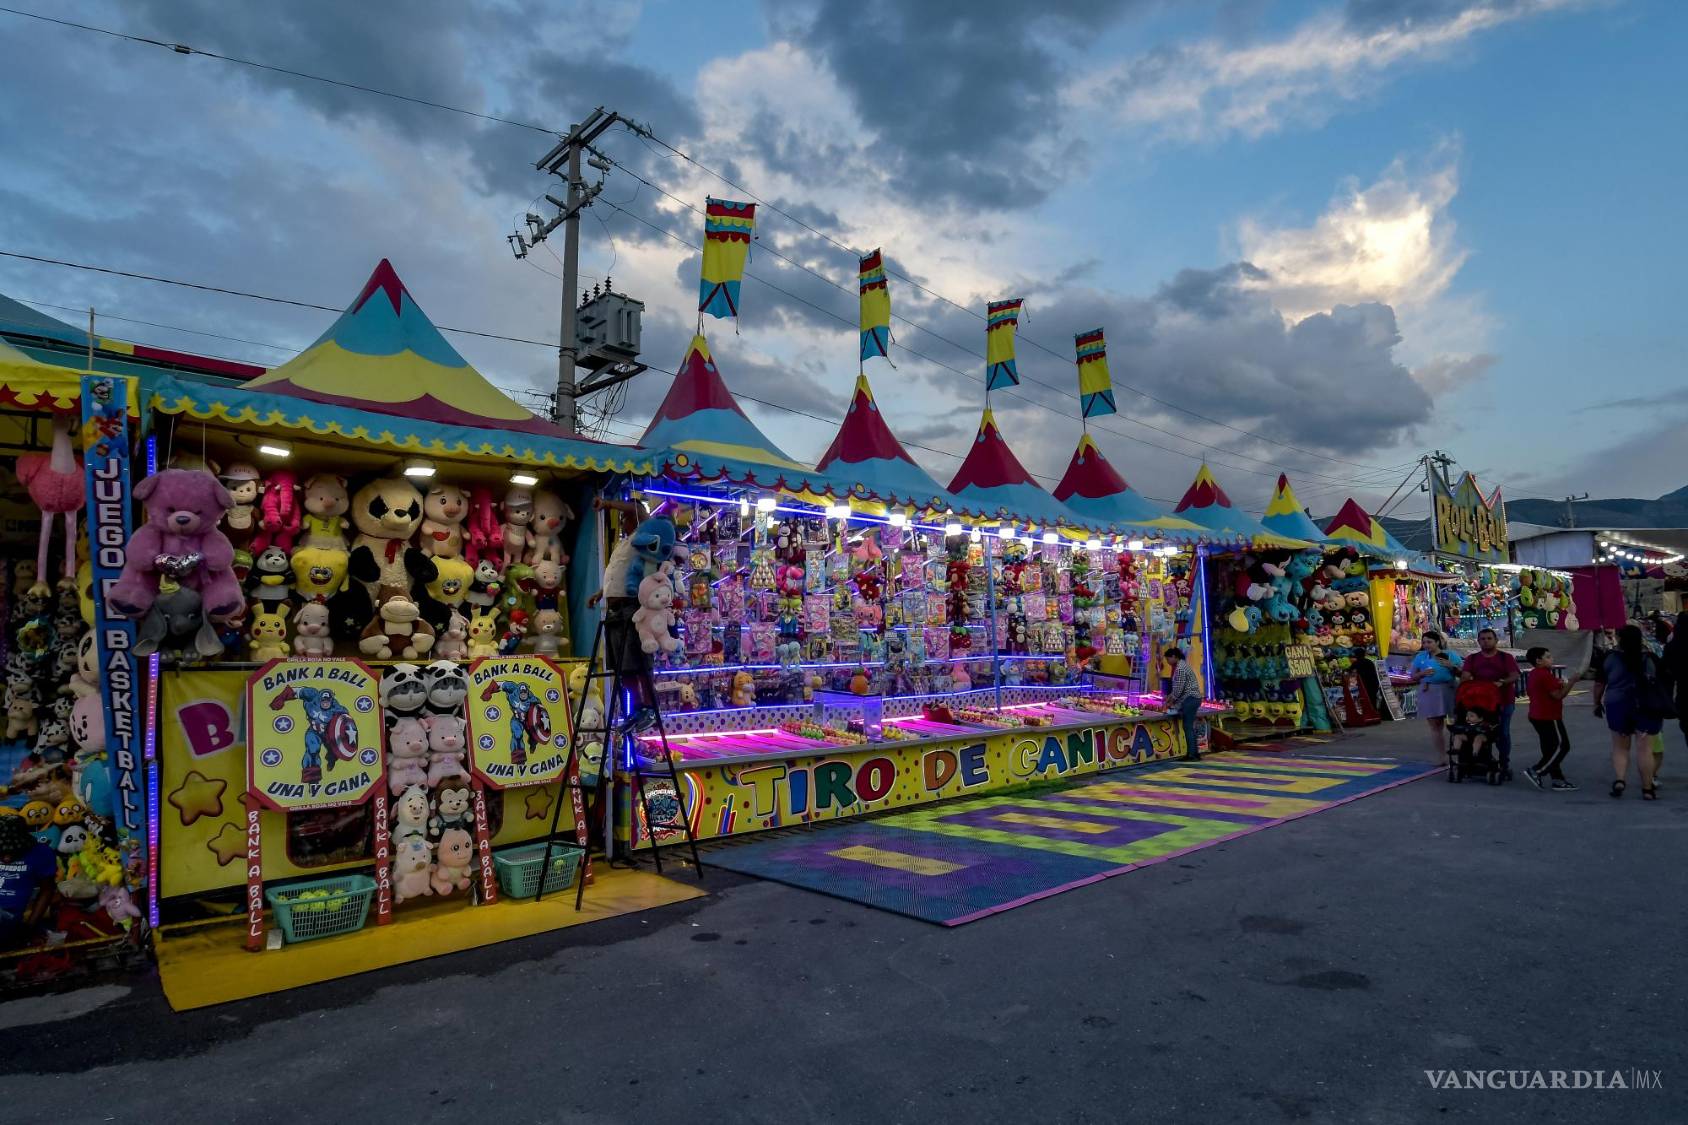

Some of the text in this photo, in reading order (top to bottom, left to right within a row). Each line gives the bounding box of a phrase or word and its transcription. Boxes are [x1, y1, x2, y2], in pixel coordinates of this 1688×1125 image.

[94, 458, 126, 568] JUEGO
[263, 667, 368, 690] BANK A BALL
[473, 663, 554, 685] BANK A BALL
[105, 629, 137, 830] BASKETBALL
[486, 763, 514, 777] UNA
[529, 754, 564, 775] GANA
[738, 719, 1173, 818] TIRO DE CANICAS
[267, 781, 305, 797] UNA
[324, 771, 371, 796] GANA
[577, 820, 587, 831] A
[375, 797, 390, 915] BANK A BALL
[480, 839, 489, 850] A
[248, 810, 263, 937] BANK A BALL
[482, 855, 495, 901] BALL
